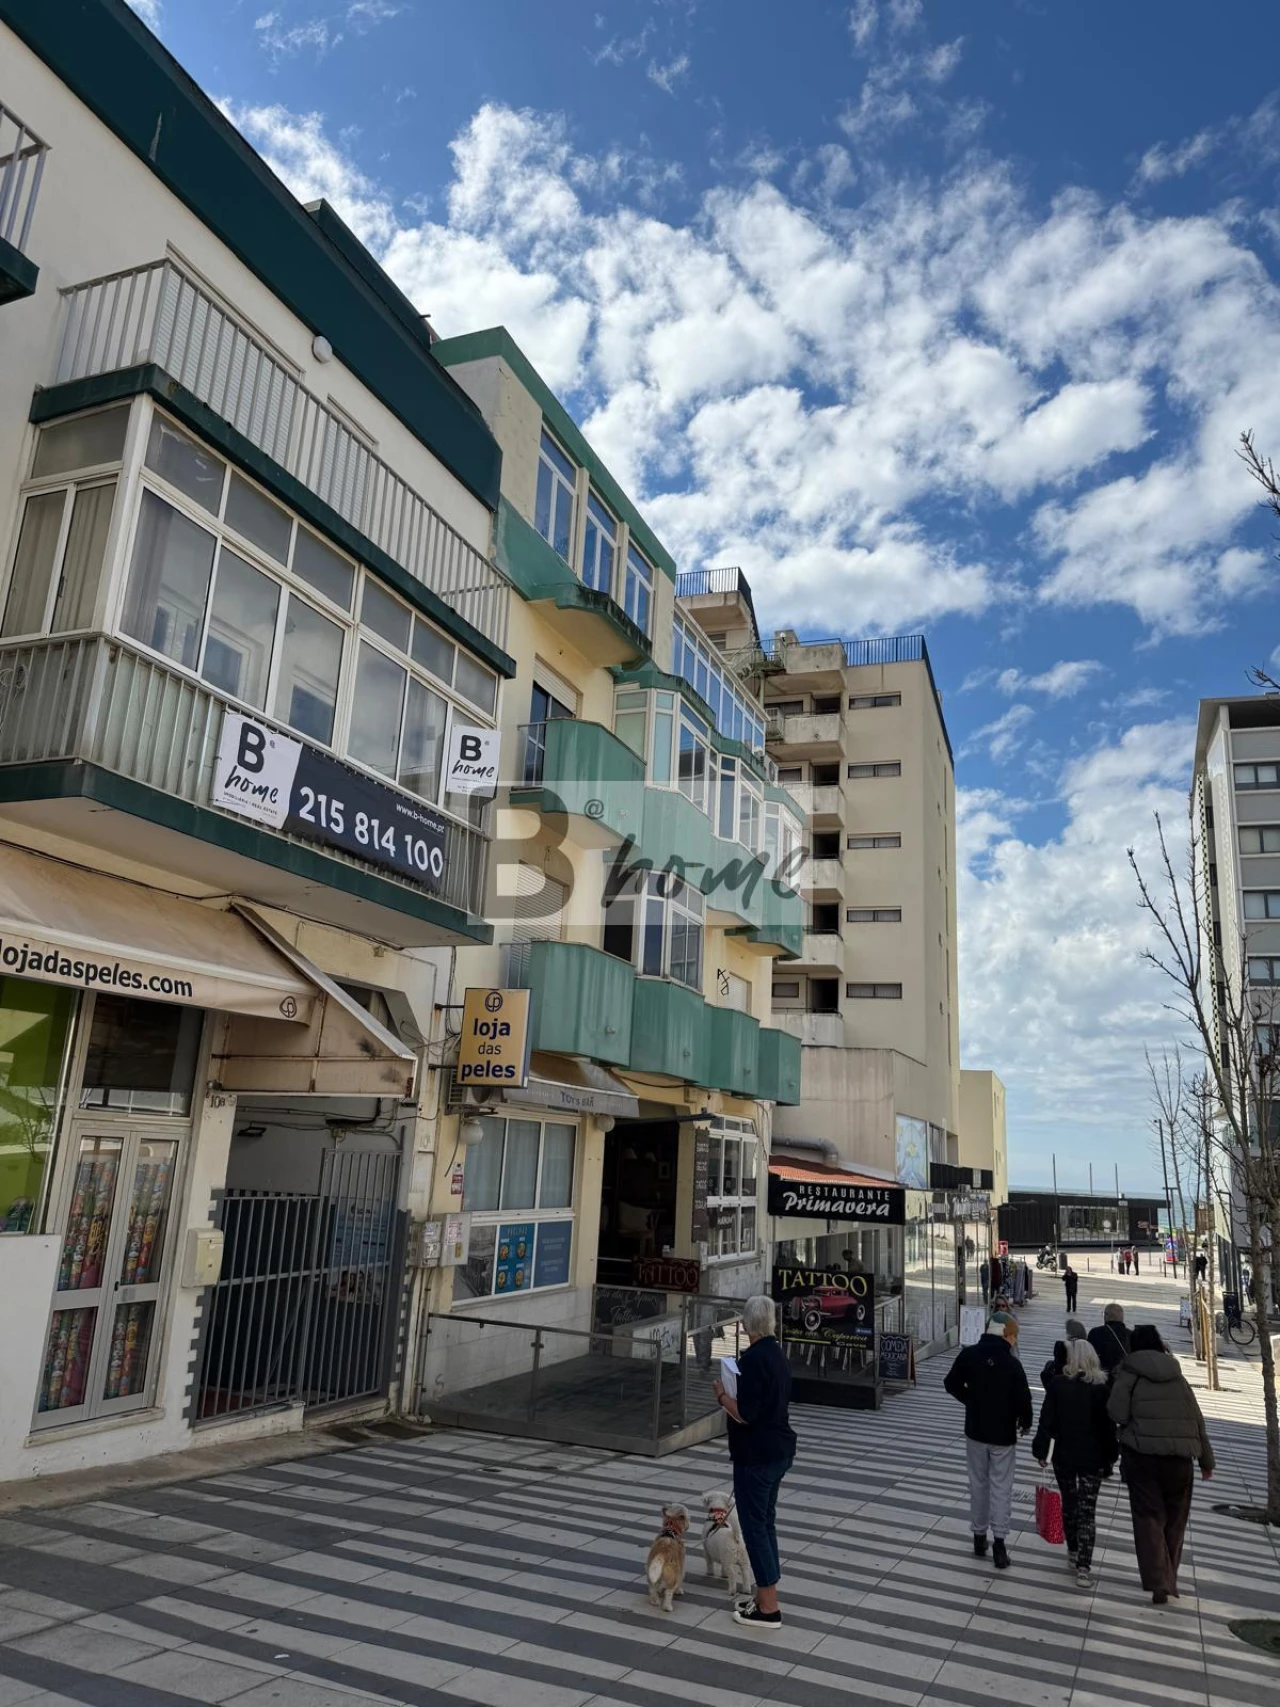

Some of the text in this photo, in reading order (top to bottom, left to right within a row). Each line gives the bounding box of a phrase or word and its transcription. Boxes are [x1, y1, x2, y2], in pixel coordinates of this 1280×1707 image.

[237, 722, 266, 773] B
[460, 735, 482, 761] B
[452, 759, 495, 778] home
[224, 765, 279, 804] home
[396, 803, 445, 834] www.b-home.pt
[299, 786, 443, 878] 215 814 100
[0, 939, 193, 998] ojadaspeles.com
[473, 1018, 511, 1039] loja
[478, 1042, 502, 1055] das
[461, 1060, 516, 1081] peles
[783, 1191, 890, 1217] Primavera
[799, 1185, 890, 1200] RESTAURANTE
[779, 1269, 867, 1297] TATTOO
